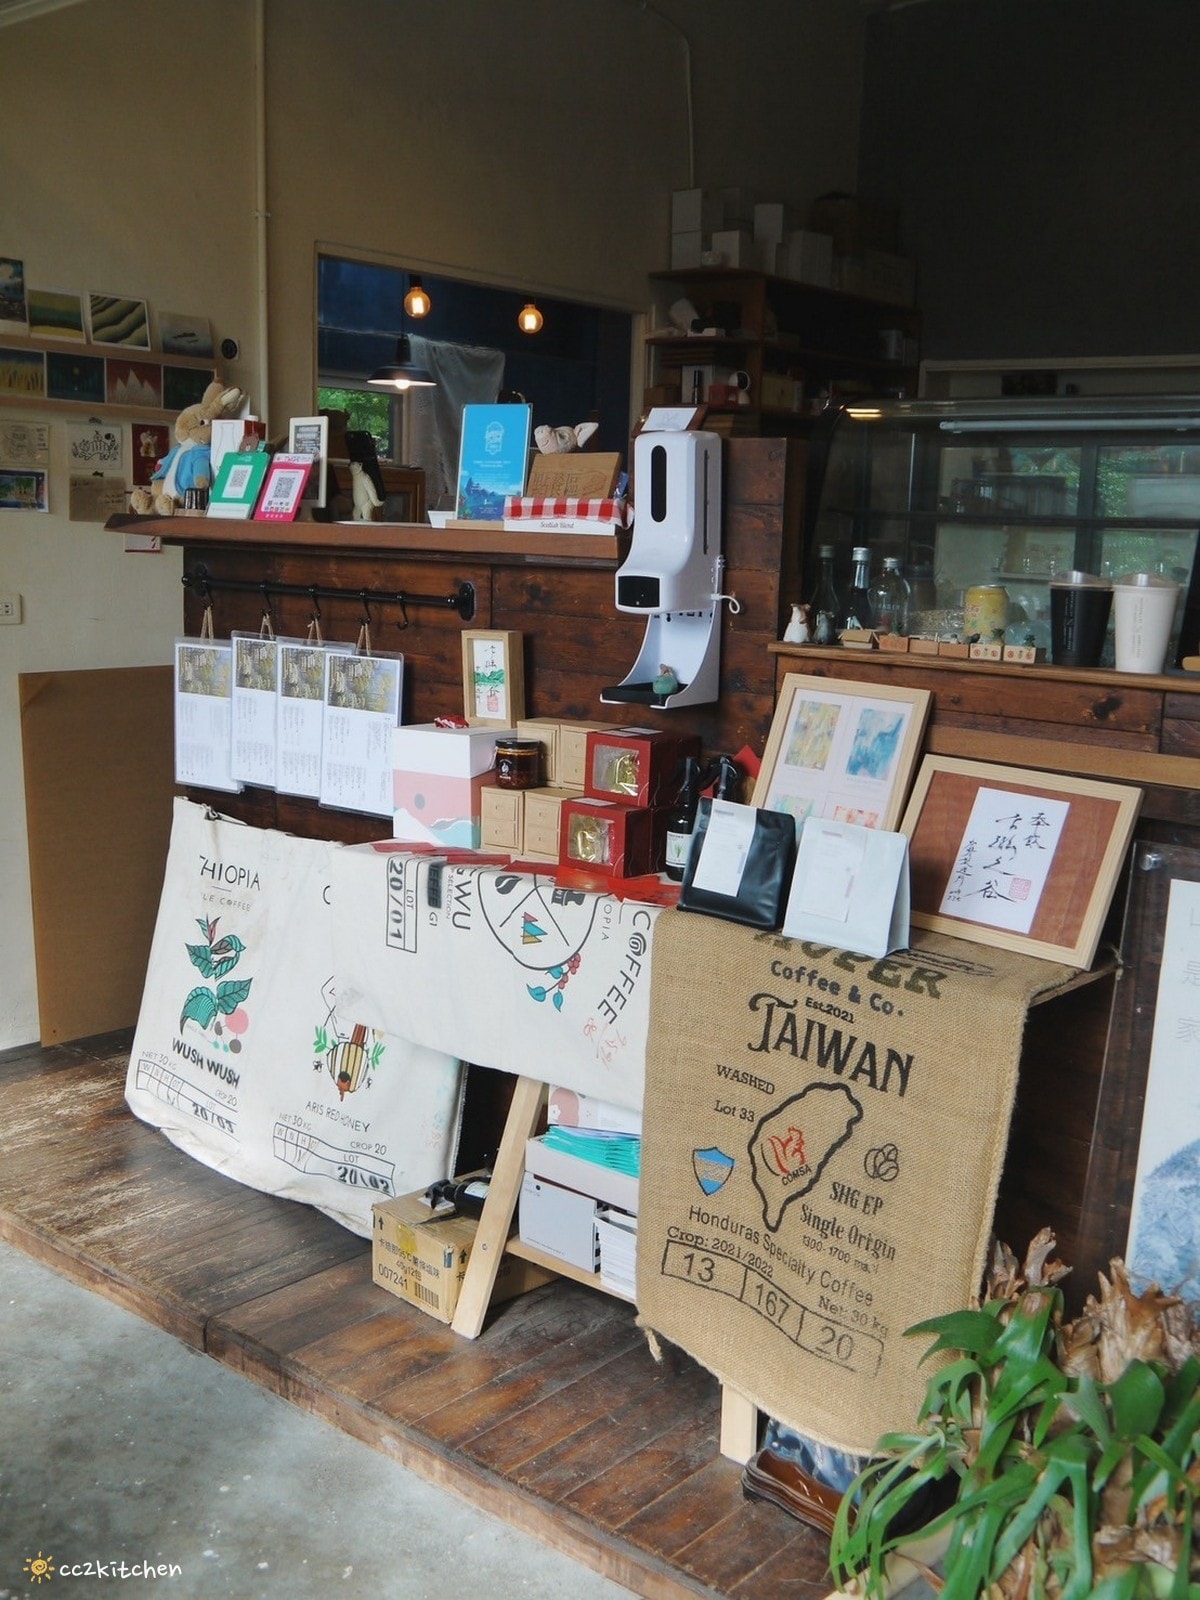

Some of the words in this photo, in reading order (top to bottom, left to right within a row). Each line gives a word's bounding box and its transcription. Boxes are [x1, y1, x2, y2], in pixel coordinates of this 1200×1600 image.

[389, 860, 403, 939] 20/01
[406, 889, 414, 910] LOT
[770, 960, 841, 996] Coffee
[848, 985, 862, 1004] &
[869, 992, 904, 1017] Co.
[747, 992, 914, 1097] TAIWAN
[172, 1037, 204, 1069] WUSH
[207, 1059, 240, 1089] WUSH
[716, 1063, 775, 1096] WASHED
[305, 1100, 324, 1116] ARIS
[714, 1100, 736, 1117] Lot
[739, 1107, 755, 1122] 33
[344, 1154, 359, 1163] LOT
[350, 1141, 373, 1151] CROP
[374, 1143, 387, 1155] 20
[781, 1164, 813, 1186] COMSA
[830, 1181, 860, 1209] SHG
[862, 1194, 883, 1215] EP
[800, 1203, 845, 1239] Single
[848, 1224, 896, 1261] Origin
[667, 1225, 708, 1248] Crop:
[713, 1237, 774, 1278] 2021/2022
[689, 1205, 761, 1245] Honduras
[763, 1233, 816, 1286] Specialty
[820, 1270, 873, 1308] Coffee
[378, 1263, 408, 1291] 007241
[684, 1252, 715, 1283] 13
[755, 1283, 790, 1324] 167
[815, 1325, 855, 1361] 20
